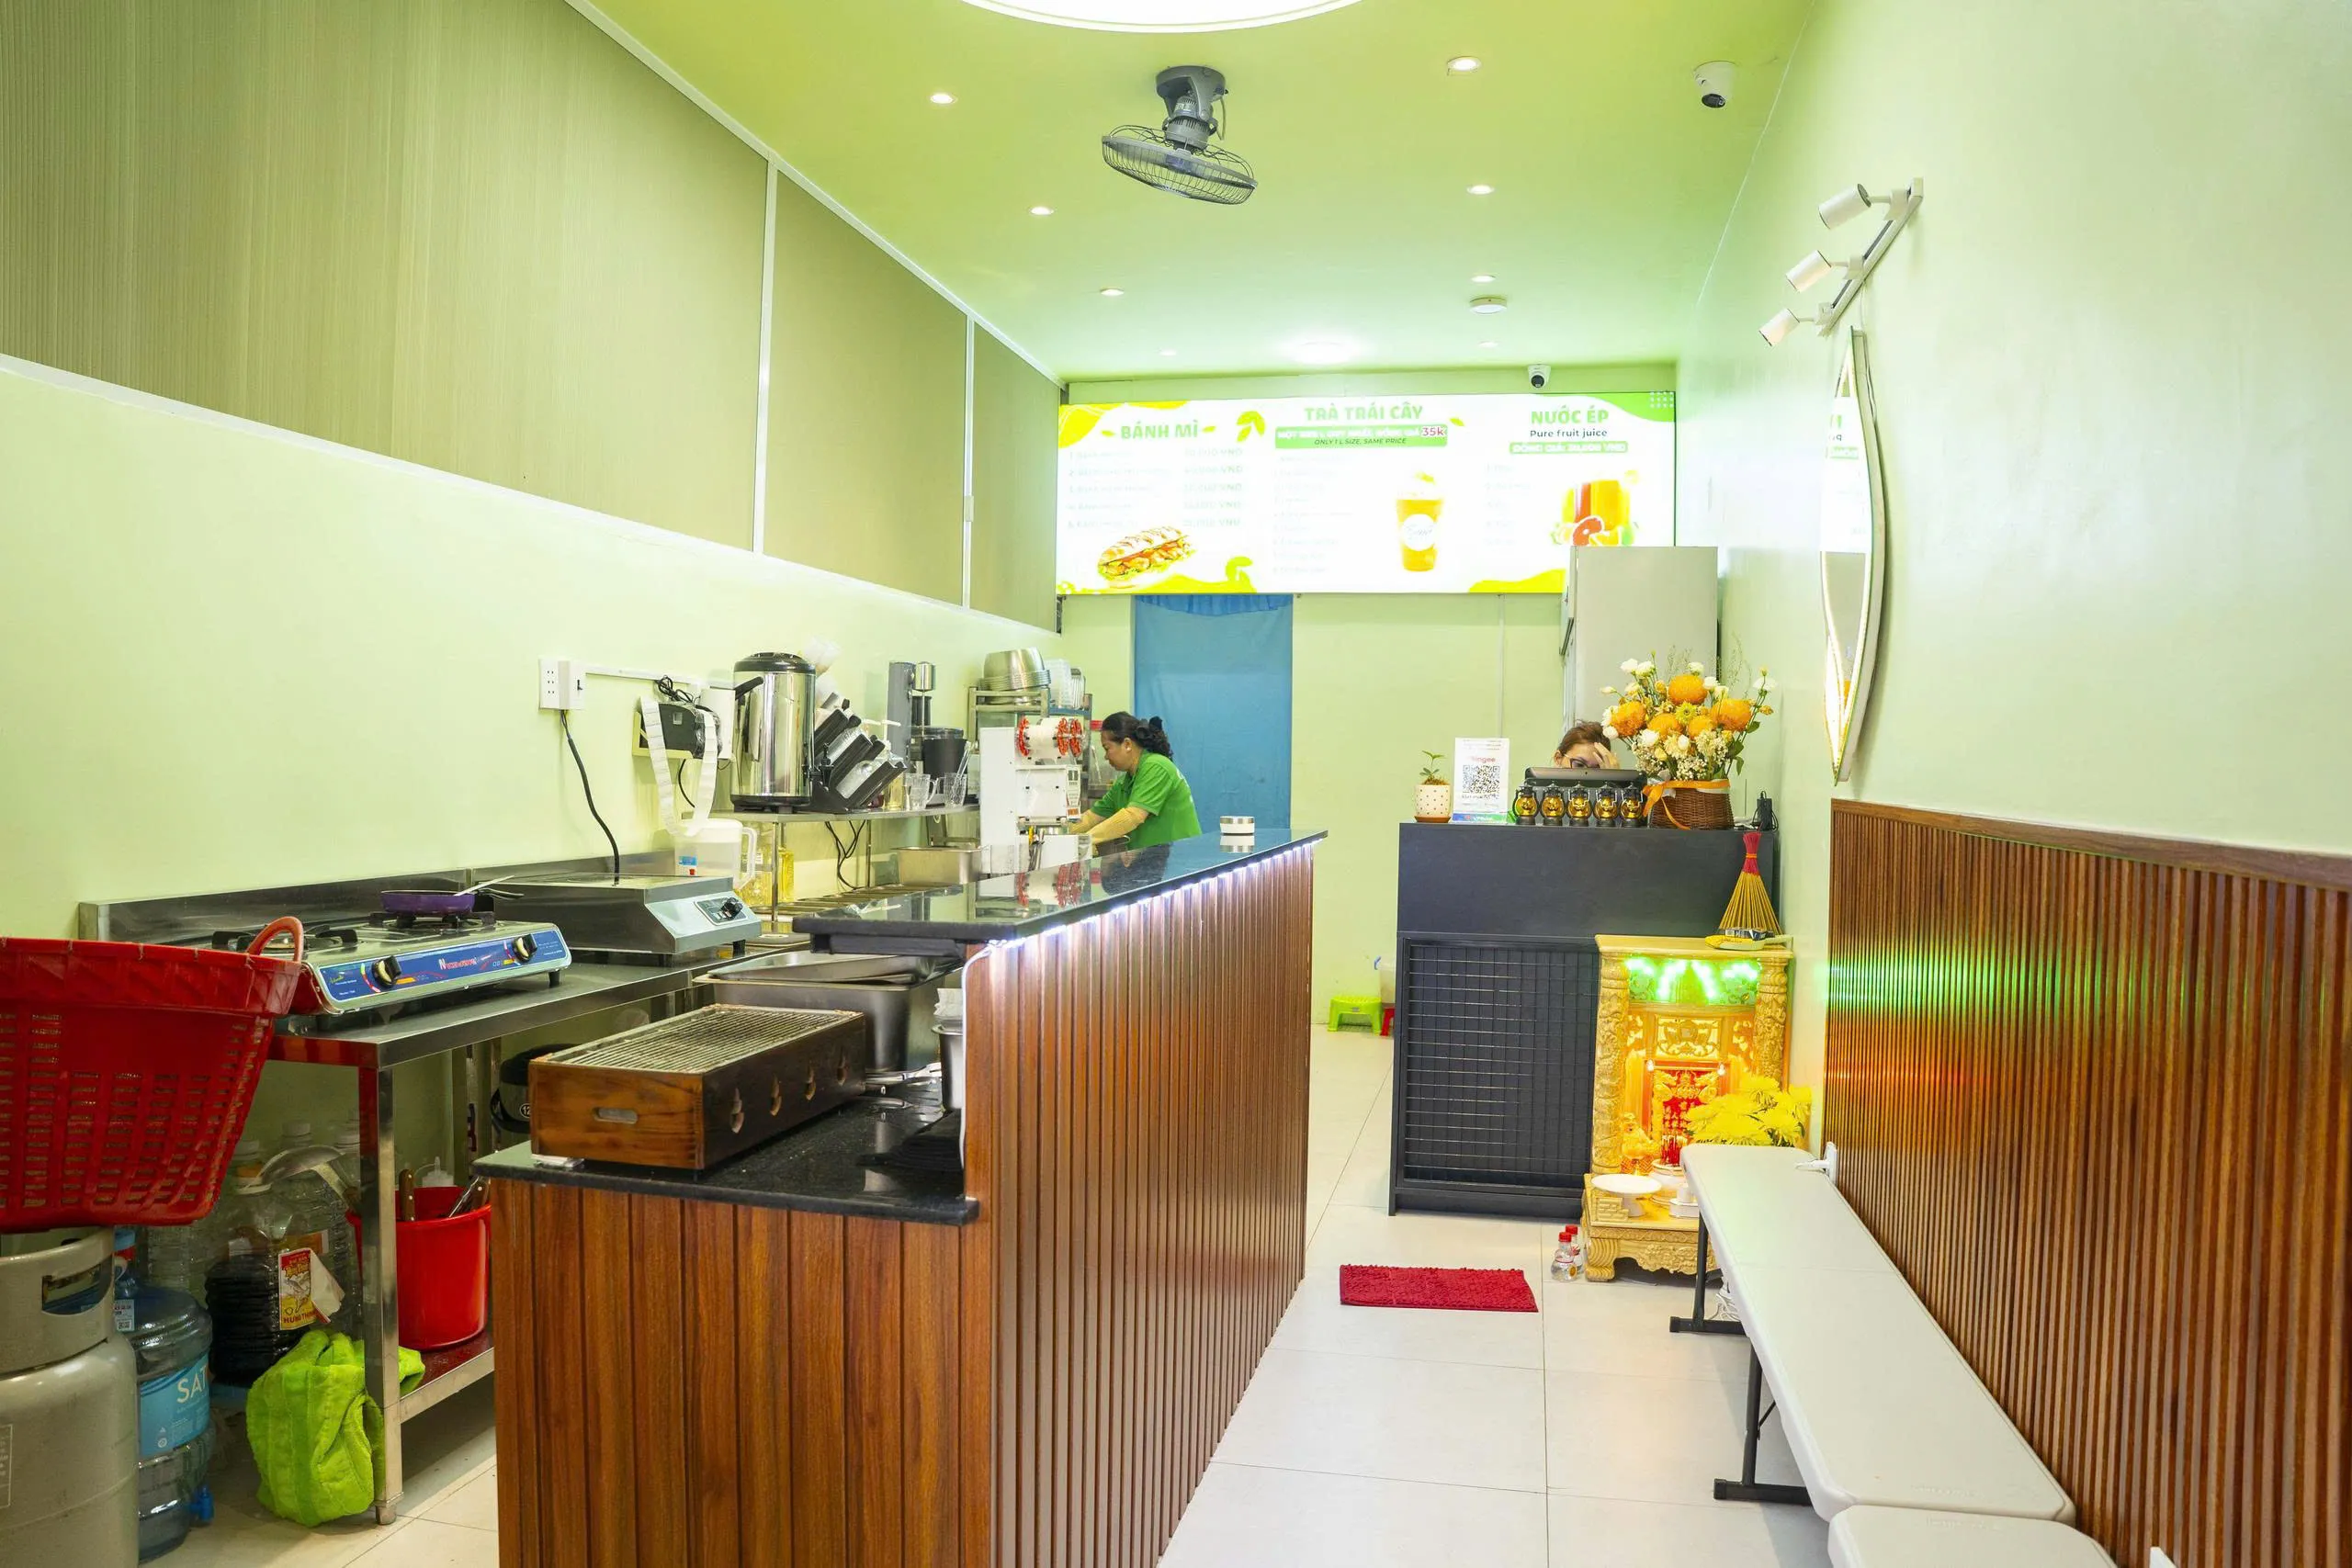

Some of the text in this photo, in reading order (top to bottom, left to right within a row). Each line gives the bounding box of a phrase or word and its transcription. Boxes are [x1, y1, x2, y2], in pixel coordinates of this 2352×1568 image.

[1305, 400, 1423, 421] TRÀ TRÁI CÂY
[1587, 405, 1609, 423] ÉP
[1120, 419, 1198, 439] BÁNH MÌ
[1422, 426, 1445, 436] 35k
[1530, 428, 1608, 439] Pure fruit juice
